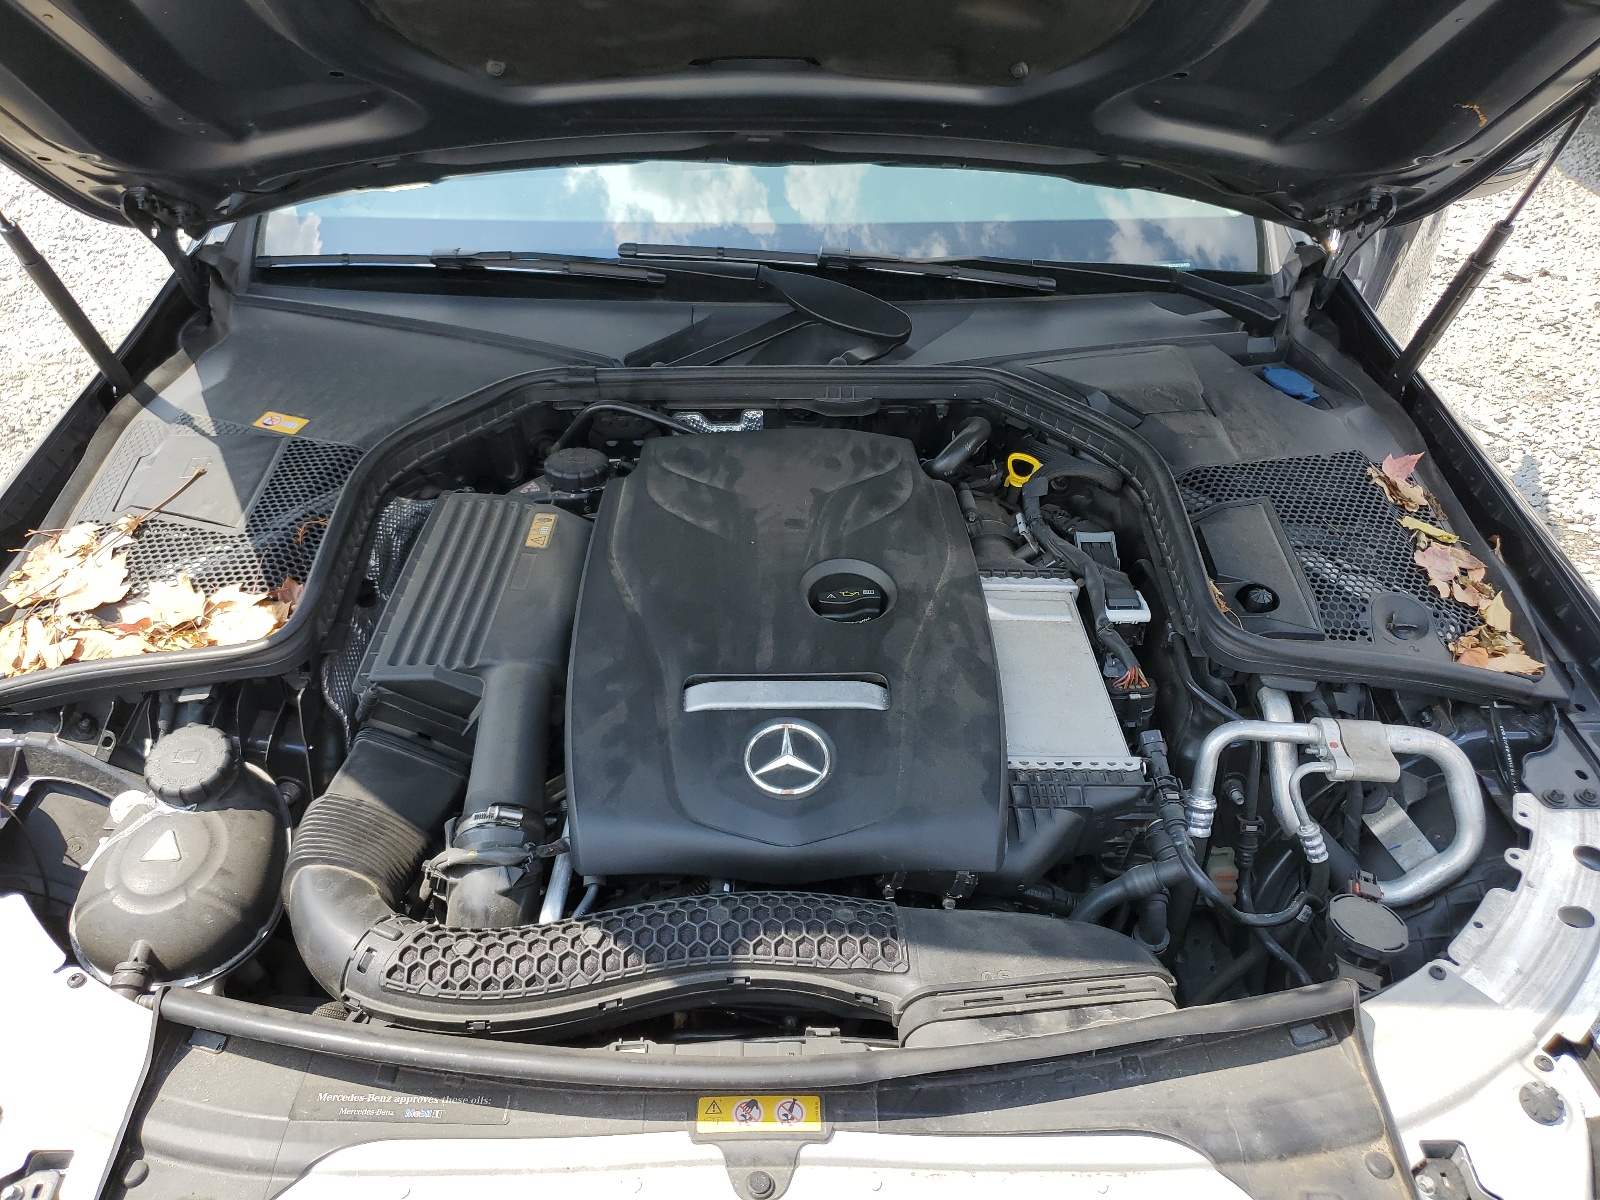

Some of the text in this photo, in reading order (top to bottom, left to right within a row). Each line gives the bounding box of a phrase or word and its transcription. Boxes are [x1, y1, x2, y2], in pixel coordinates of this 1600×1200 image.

[316, 1092, 392, 1103] Mercedes-Benz
[393, 1096, 439, 1105] approves
[441, 1096, 469, 1104] these
[338, 1107, 395, 1117] Mercedes-Benz
